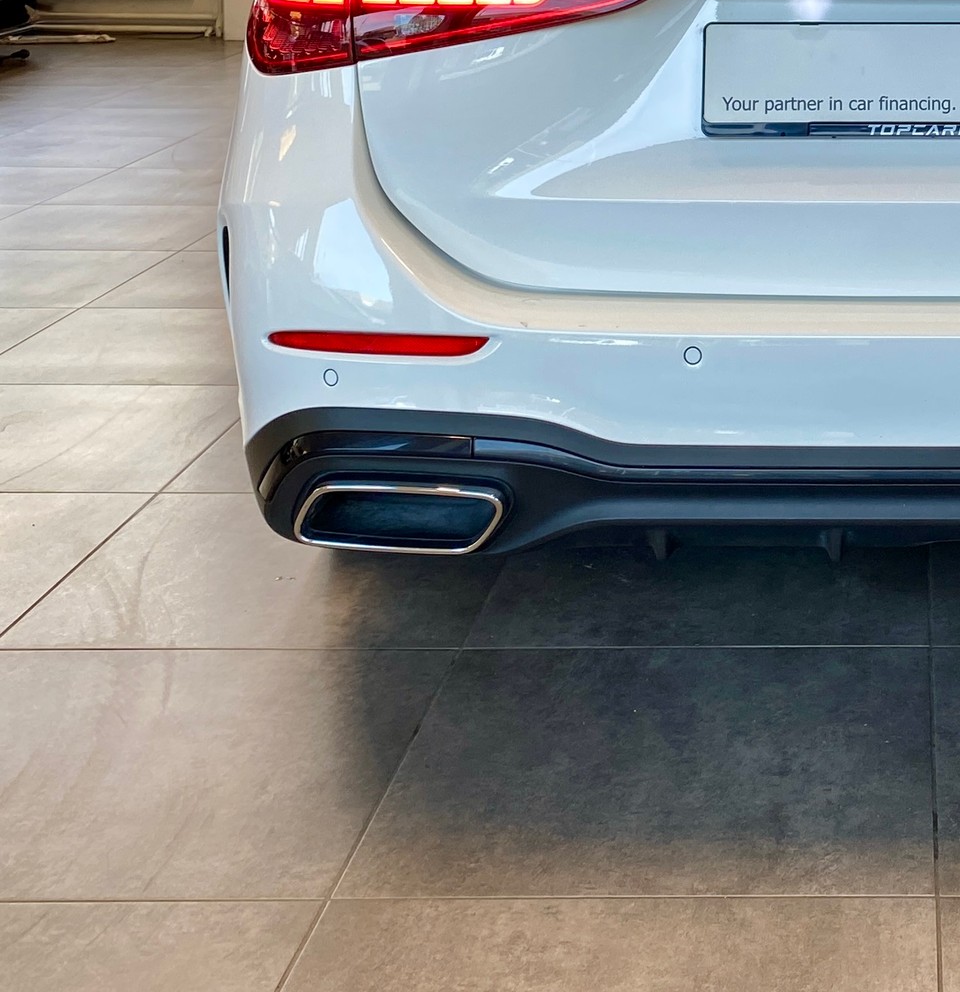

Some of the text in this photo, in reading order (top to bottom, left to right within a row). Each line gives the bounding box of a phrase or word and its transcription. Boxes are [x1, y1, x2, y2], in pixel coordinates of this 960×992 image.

[722, 96, 957, 114] Your partner in car financing.
[867, 124, 957, 136] TOPCAR
